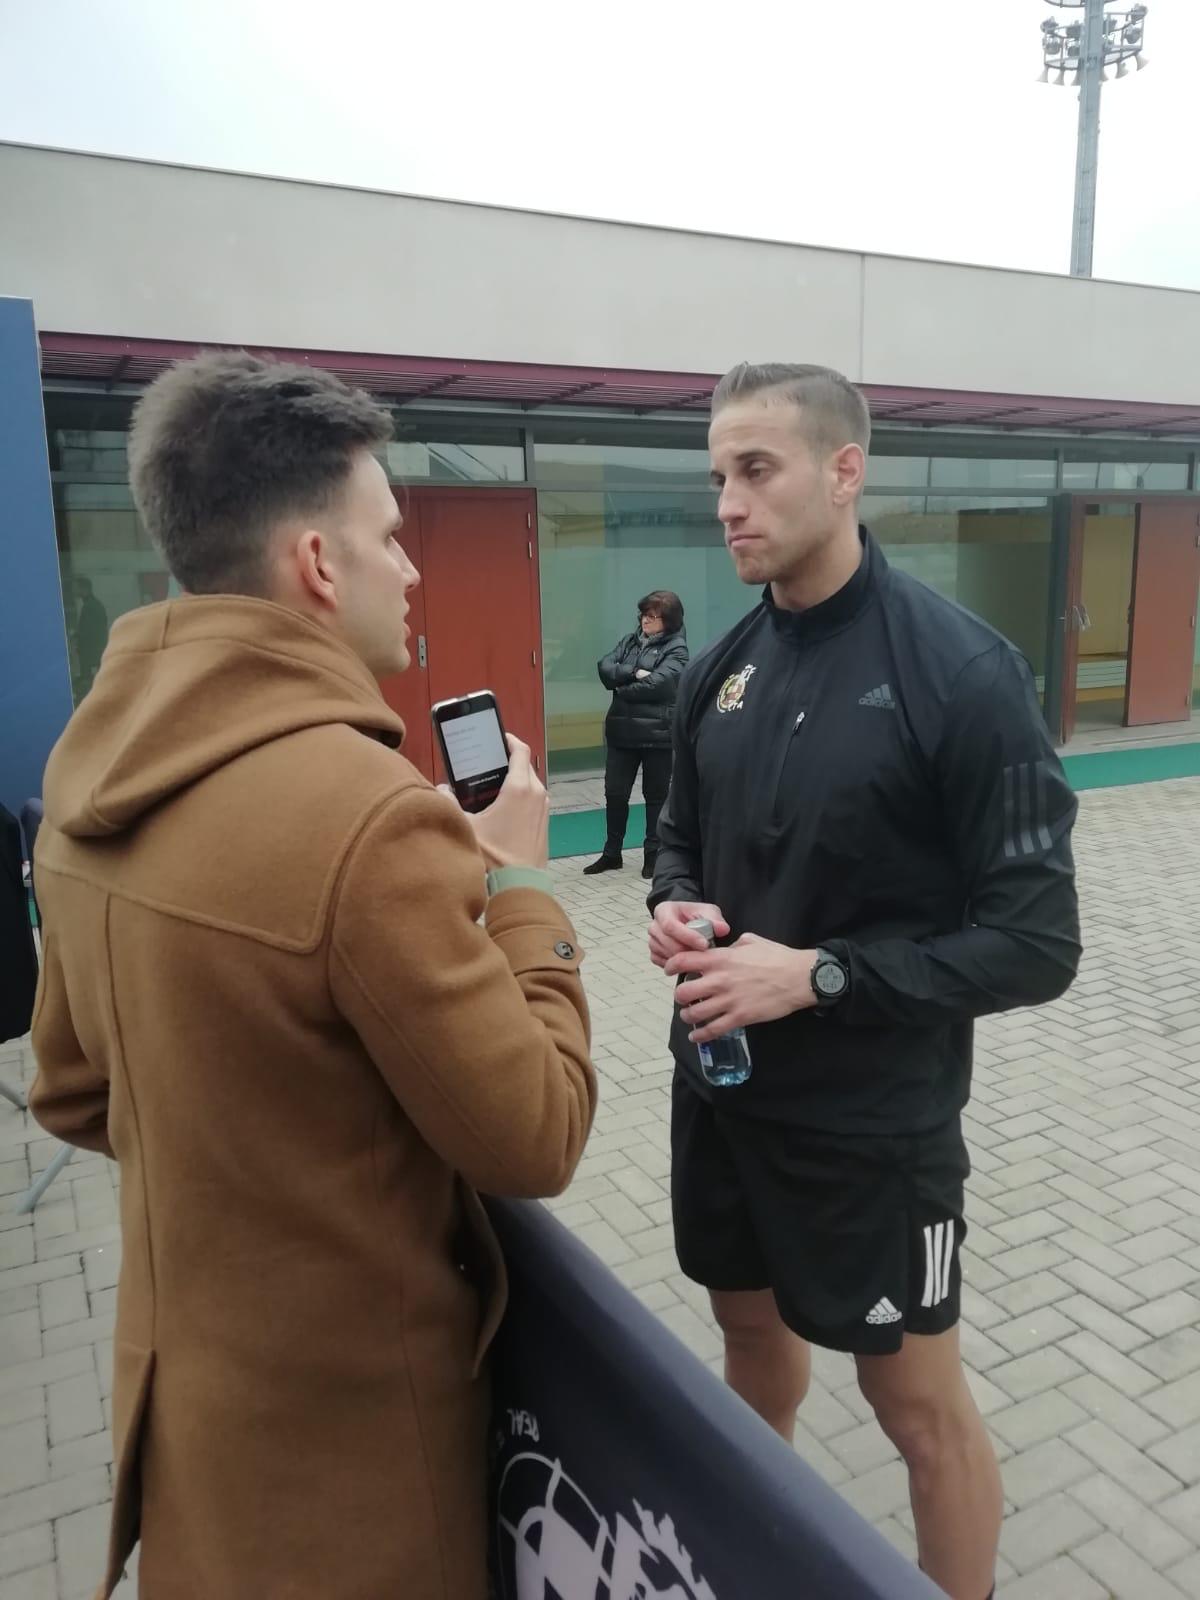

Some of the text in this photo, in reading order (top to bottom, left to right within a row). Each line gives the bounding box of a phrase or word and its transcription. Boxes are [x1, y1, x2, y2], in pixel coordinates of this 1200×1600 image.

[859, 697, 896, 709] adidas
[865, 1311, 902, 1324] adidas
[506, 1408, 540, 1442] REAL
